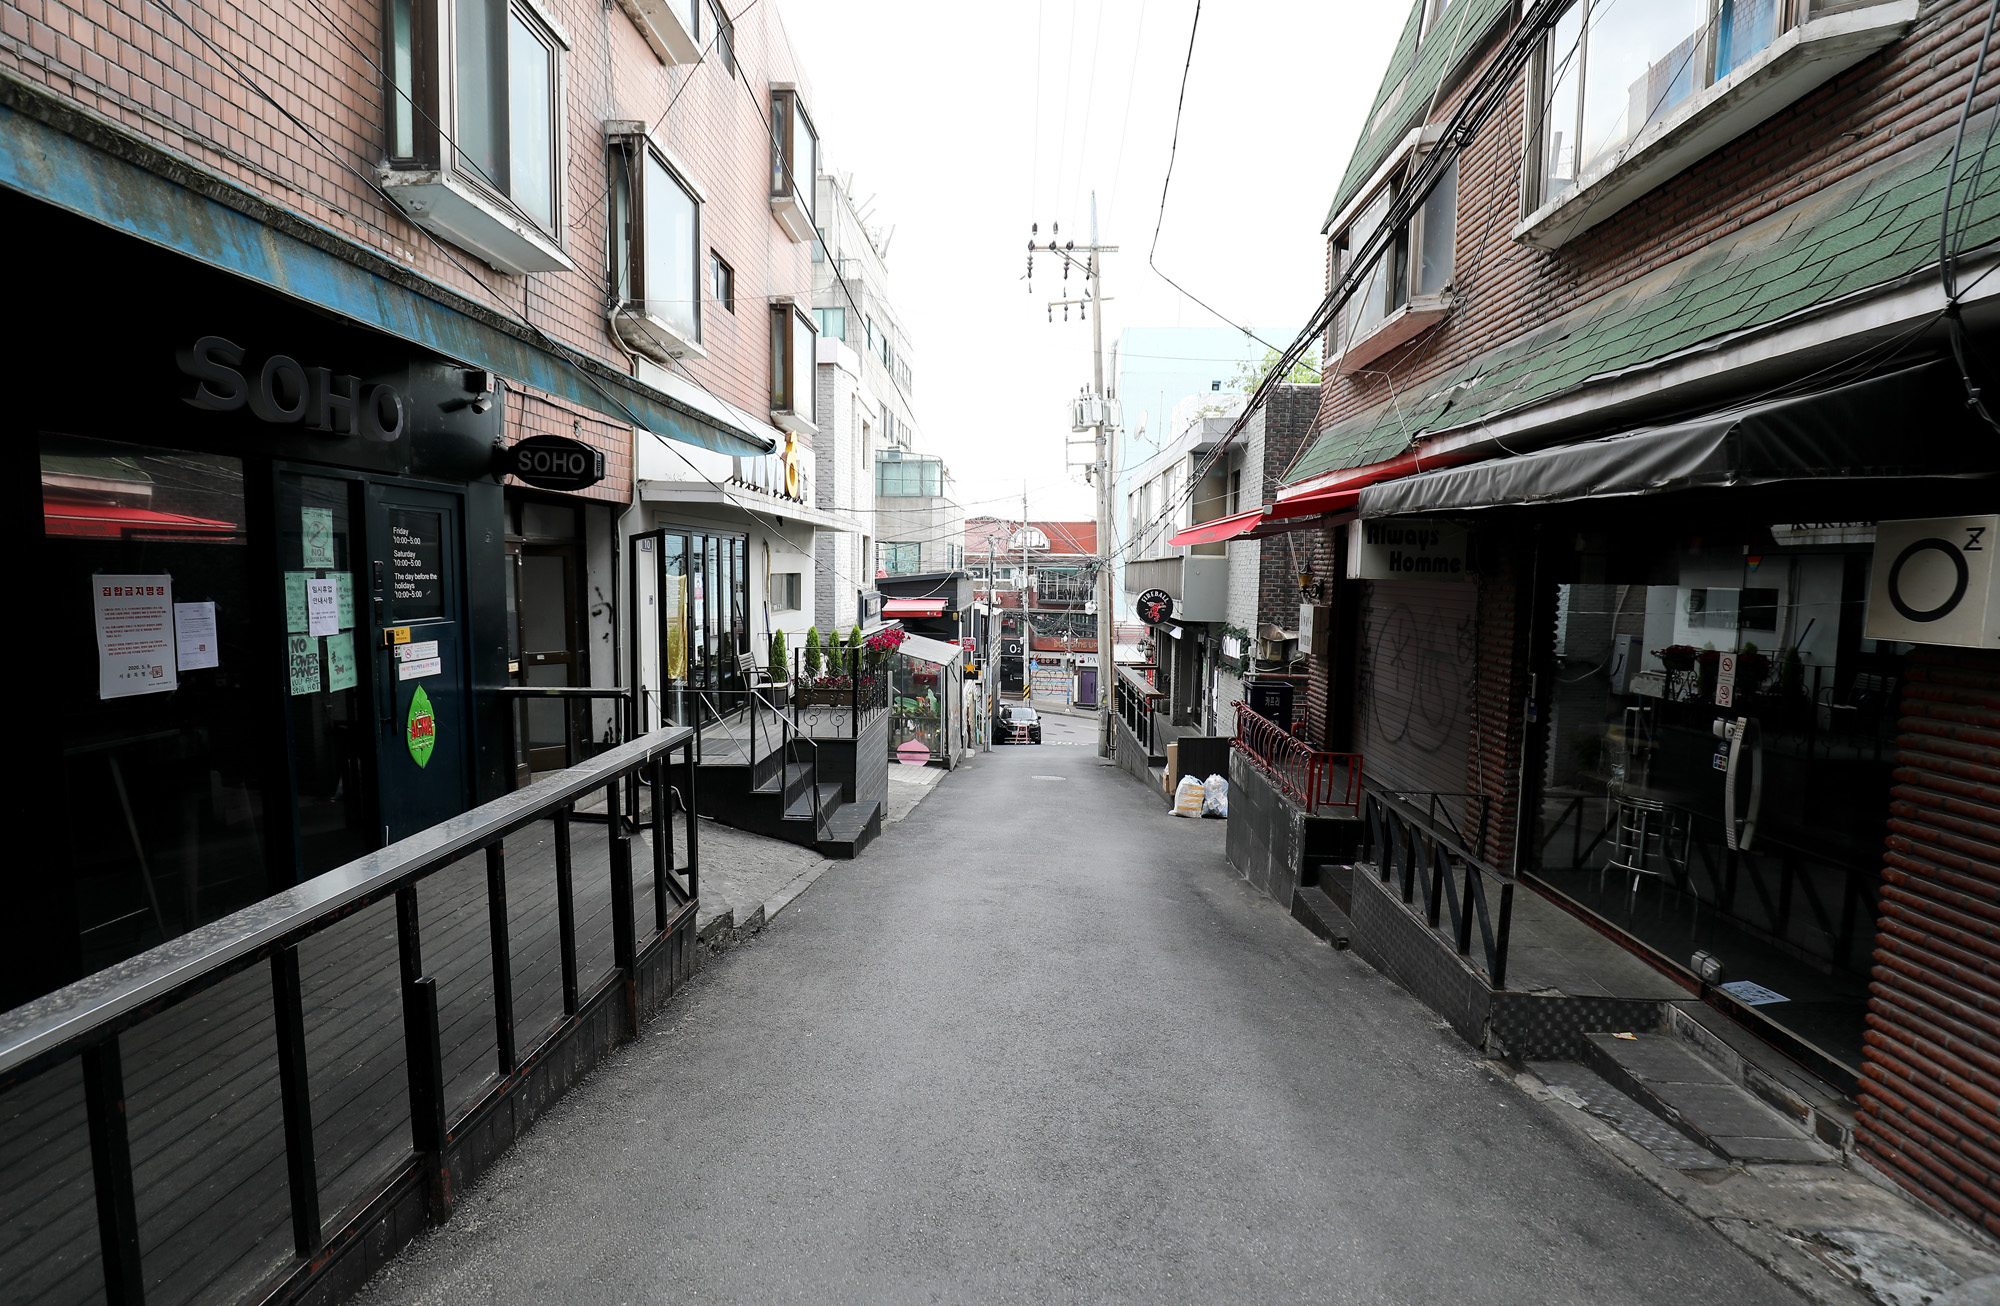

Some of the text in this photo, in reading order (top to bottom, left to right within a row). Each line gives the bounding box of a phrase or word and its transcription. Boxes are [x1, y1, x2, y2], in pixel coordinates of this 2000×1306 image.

[190, 335, 404, 442] SOHO
[518, 450, 586, 474] SOHO
[393, 527, 409, 537] Friday
[1367, 523, 1440, 551] Always
[644, 541, 650, 550] 10
[394, 550, 416, 561] Saturday
[1389, 551, 1461, 573] Homme
[394, 571, 438, 582] The day before the
[394, 580, 415, 590] holidays
[103, 586, 165, 597] 집합금지명령
[1141, 591, 1169, 603] FIREBALL
[313, 597, 333, 605] 안내사항
[291, 638, 307, 653] NO
[291, 653, 319, 667] POWER
[291, 666, 319, 678] DANCE
[1264, 696, 1281, 707] 카프리
